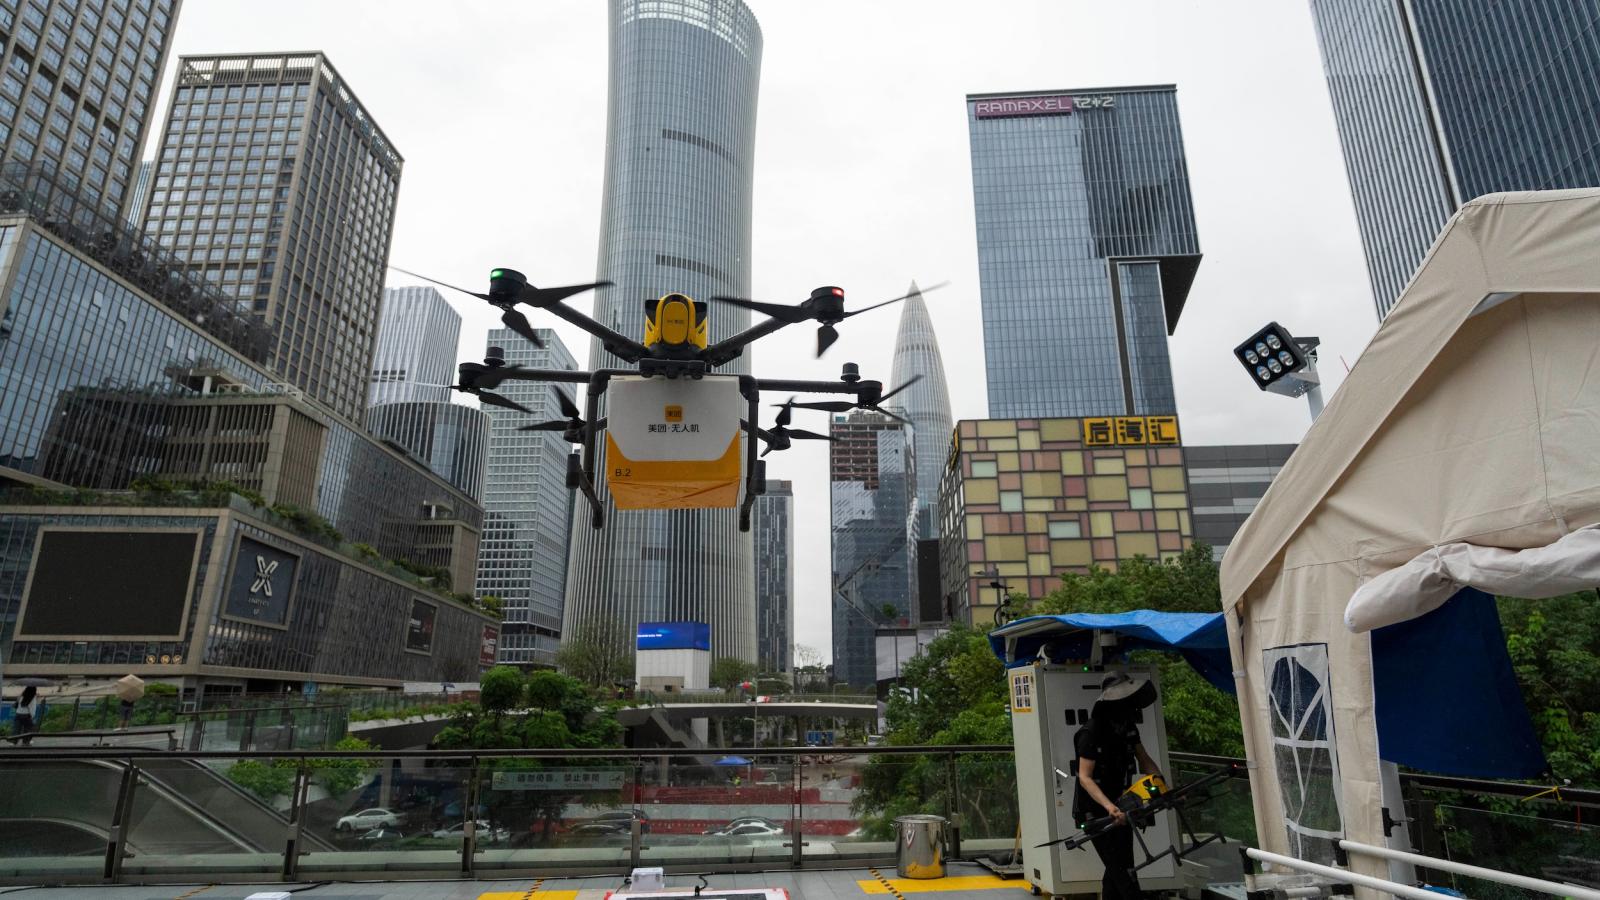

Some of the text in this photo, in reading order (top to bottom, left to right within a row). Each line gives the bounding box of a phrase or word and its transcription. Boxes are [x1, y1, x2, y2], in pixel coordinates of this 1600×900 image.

[977, 99, 1071, 113] RAMAXEL
[1087, 418, 1176, 443] 后海汇
[615, 468, 631, 477] B.2
